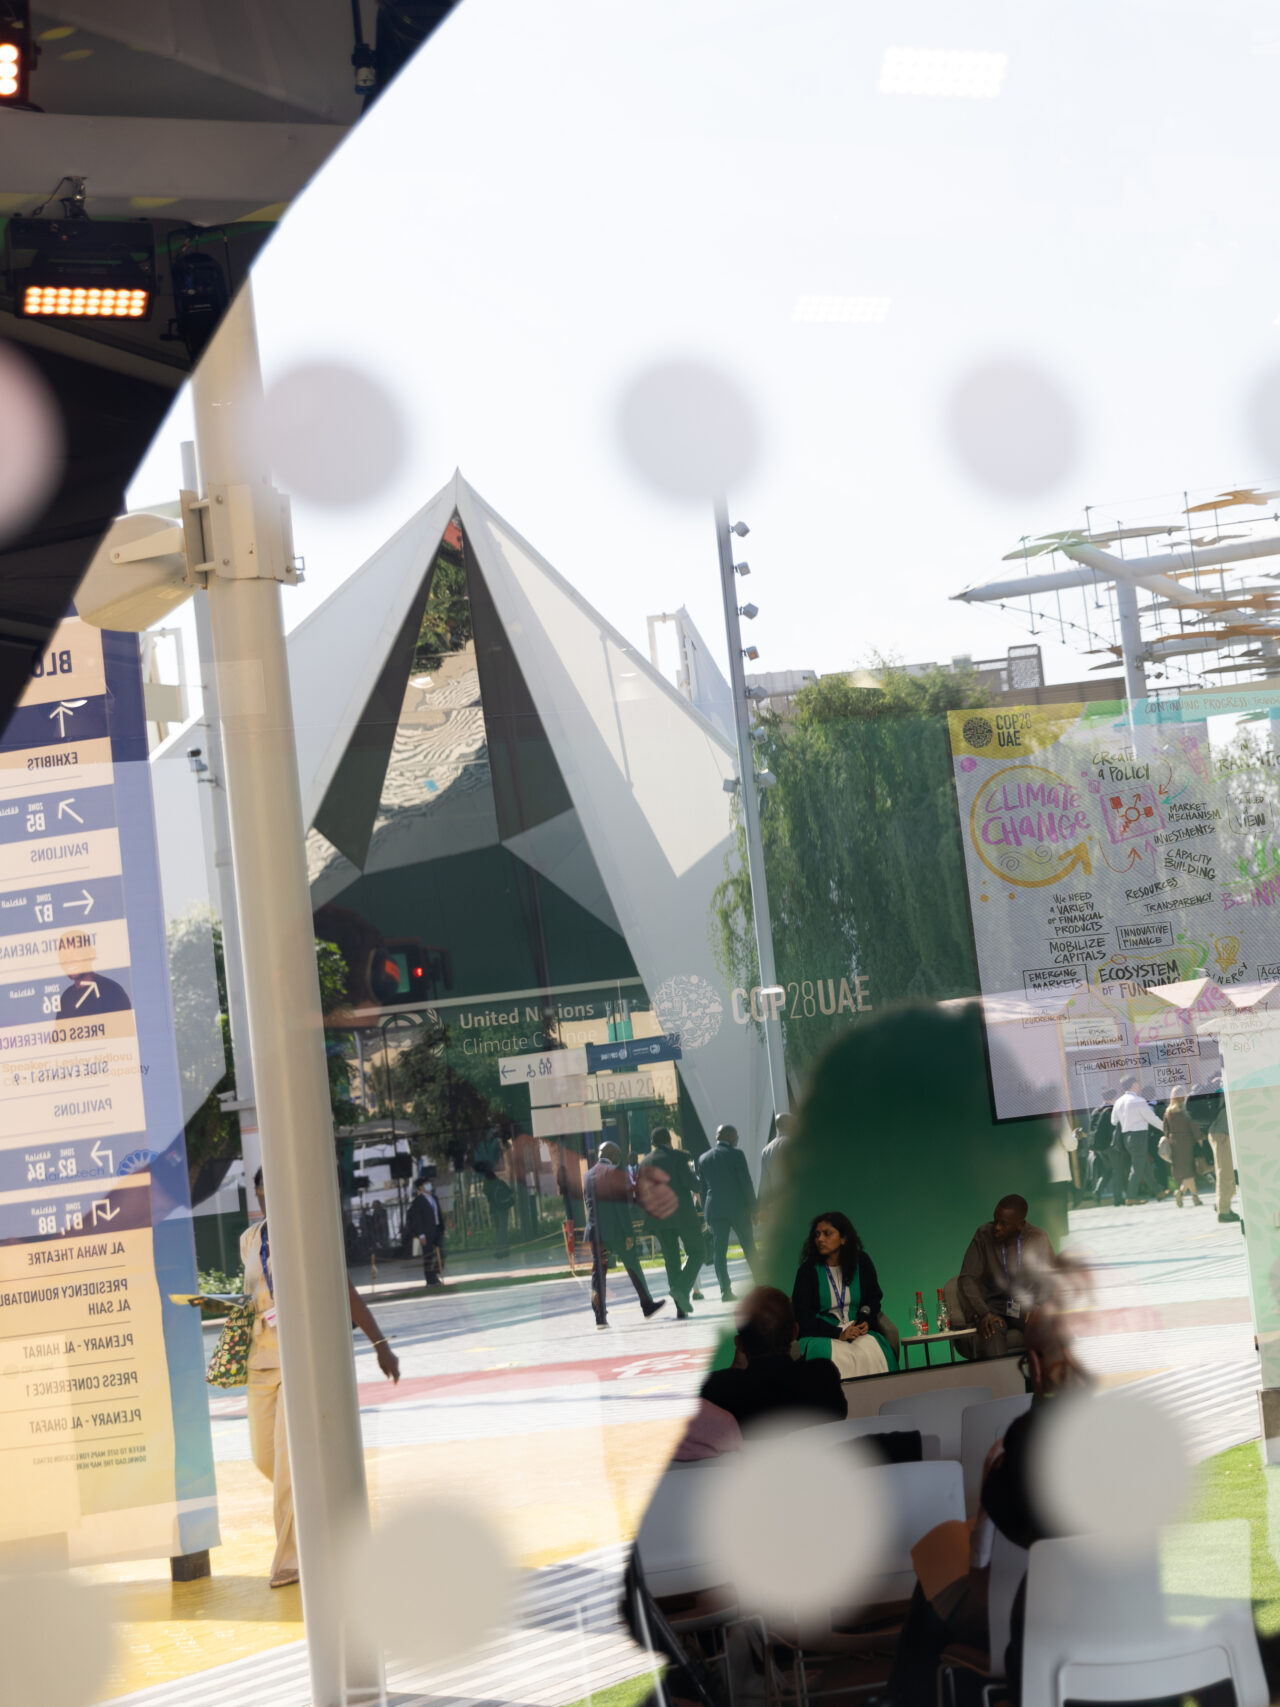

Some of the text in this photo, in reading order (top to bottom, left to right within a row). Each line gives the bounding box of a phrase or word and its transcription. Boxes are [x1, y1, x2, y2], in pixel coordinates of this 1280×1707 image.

[995, 713, 1033, 731] COP28
[997, 731, 1022, 748] UAE
[1109, 763, 1150, 783] POLICY
[1169, 802, 1208, 813] MARKET
[1168, 809, 1223, 822] MECHANISM
[1153, 824, 1217, 844] INVESTMENTS
[1166, 849, 1212, 865] CAPACITY
[1164, 857, 1217, 880] BUILDING
[1124, 876, 1180, 900] RESOURCES
[1068, 891, 1093, 902] NEED
[1143, 892, 1213, 914] TRANSPARENCY
[1056, 902, 1095, 916] VARIETY
[1058, 912, 1105, 925] FINANCIAL
[1054, 922, 1103, 937] PRODUCTS
[1119, 924, 1169, 938] INNOVATIVE
[1049, 938, 1107, 955] MOBILIZE
[1123, 936, 1163, 948] FINANCE
[1054, 950, 1107, 965] CAPITALS
[1028, 968, 1078, 982] EMERGING
[1099, 959, 1181, 983] ECOSYSTEM
[1031, 978, 1083, 992] MARKETS
[459, 1007, 519, 1029] United
[462, 1036, 528, 1056] Climate
[1160, 1045, 1196, 1057] SECTOR
[1079, 1056, 1149, 1072] PHILANTHROPISTS
[1156, 1067, 1184, 1077] PUBLIC
[1157, 1074, 1187, 1085] SECTOR
